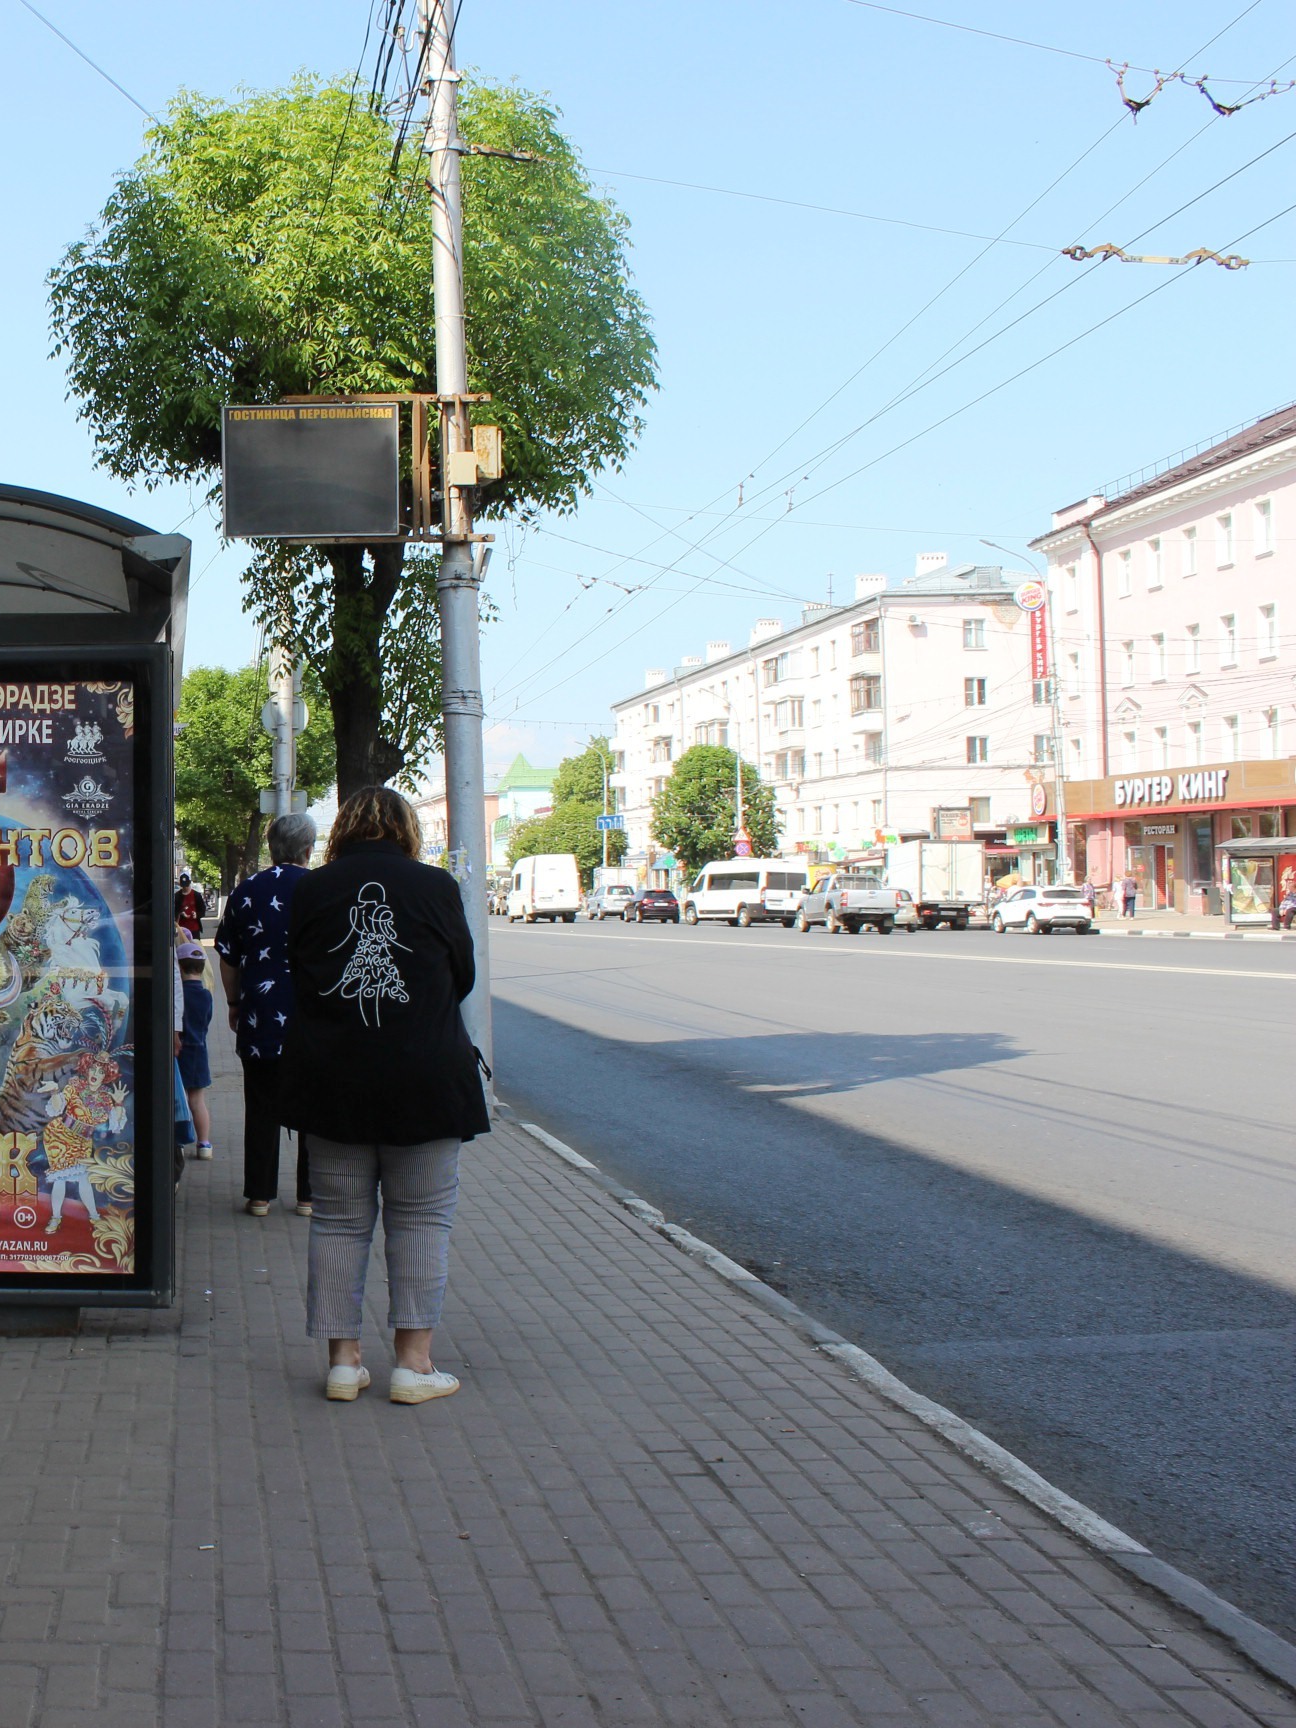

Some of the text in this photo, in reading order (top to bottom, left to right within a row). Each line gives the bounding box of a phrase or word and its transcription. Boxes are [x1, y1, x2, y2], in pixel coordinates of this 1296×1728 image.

[229, 406, 393, 420] ГОСТИНИЦА ПЕРВОМАЙСКАЯ
[1021, 592, 1042, 604] KING
[1115, 770, 1229, 805] БУРГЕР КИНГ
[1143, 825, 1177, 835] РЕСТОРАН
[360, 929, 385, 942] too
[17, 1212, 33, 1222] 0+
